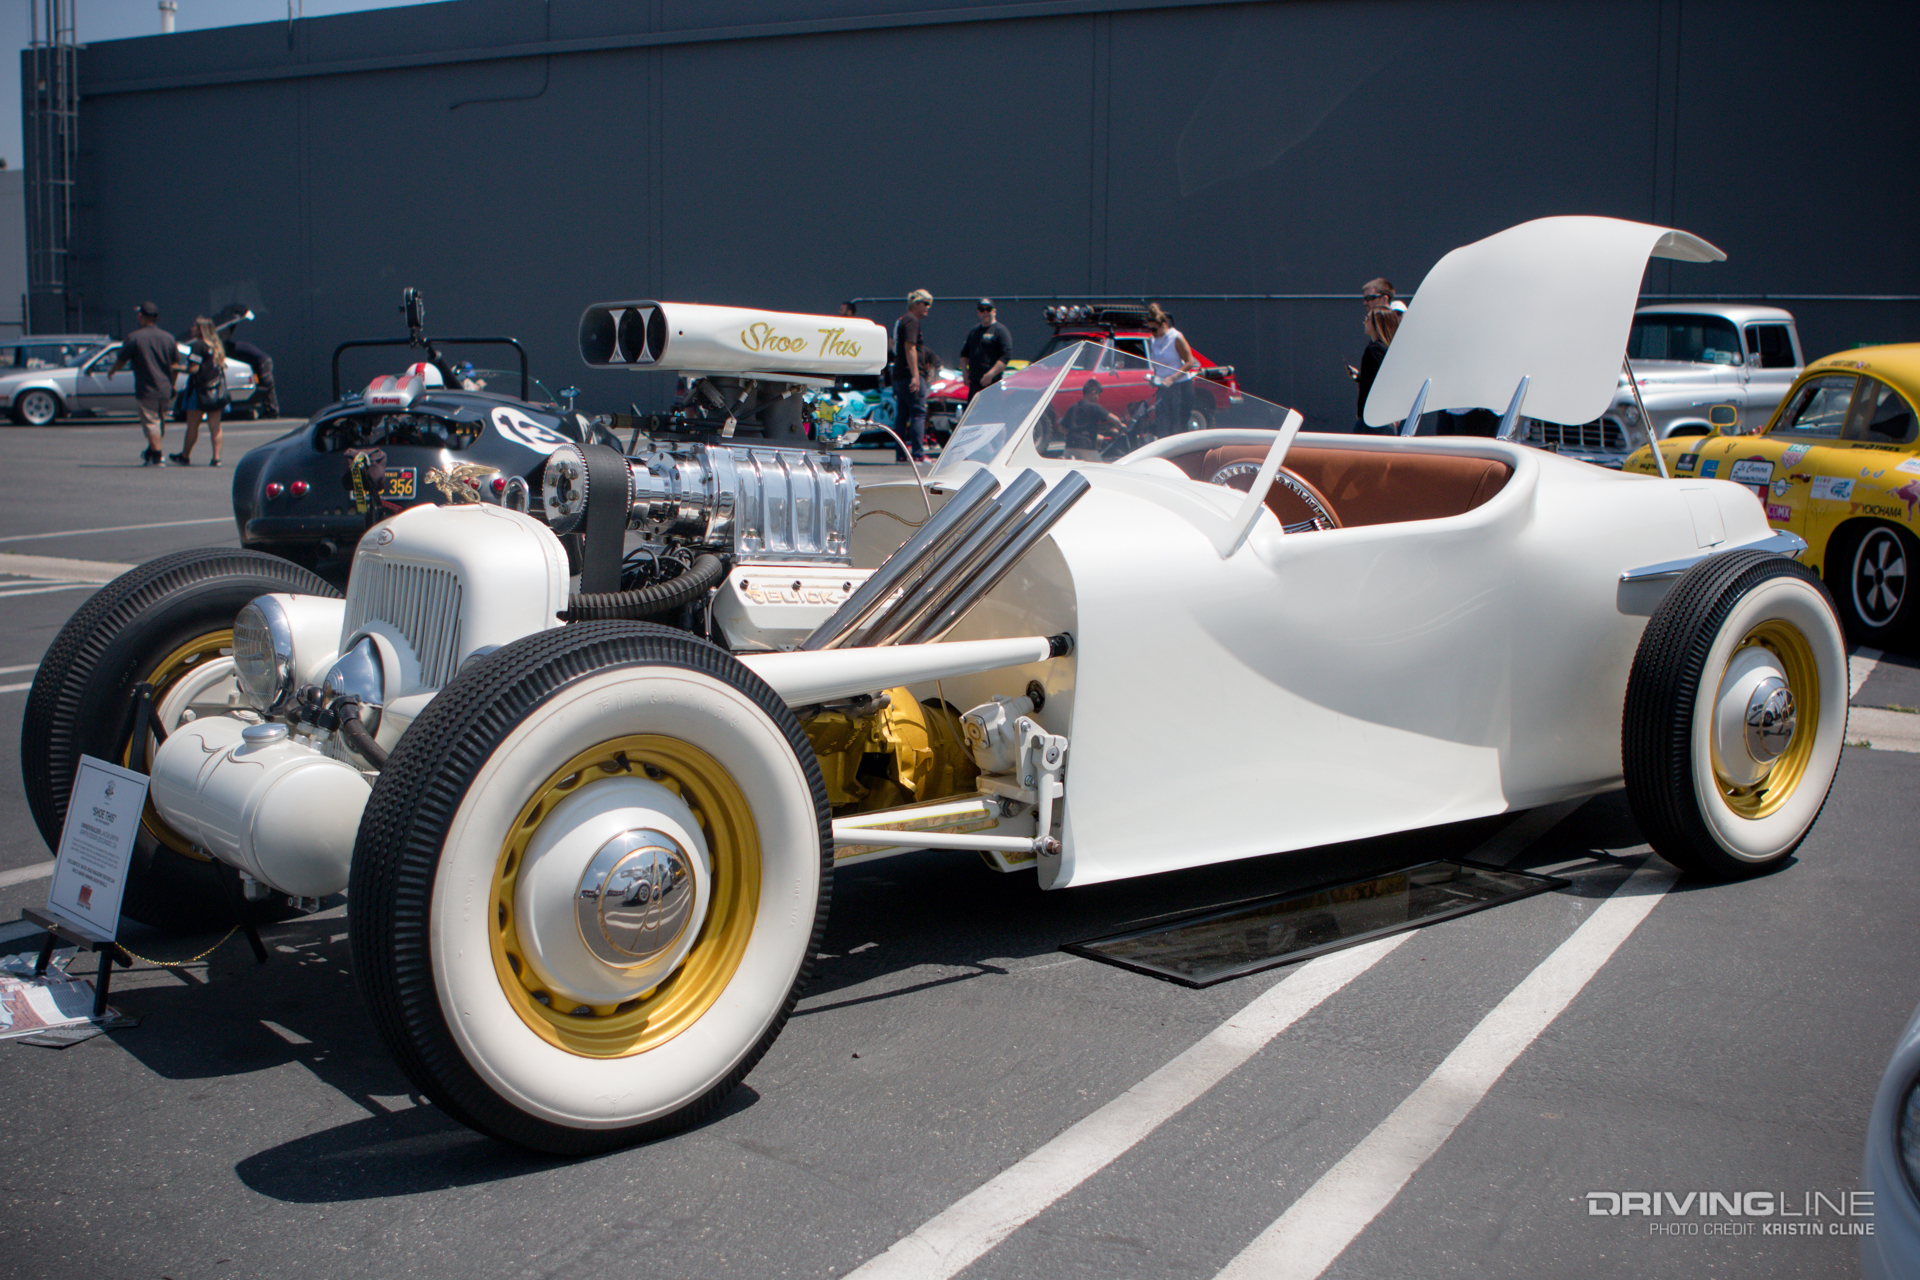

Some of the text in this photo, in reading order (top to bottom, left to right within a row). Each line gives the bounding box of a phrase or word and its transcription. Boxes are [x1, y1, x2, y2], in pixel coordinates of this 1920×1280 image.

[741, 321, 861, 358] Shoe This
[498, 414, 570, 444] 13
[1787, 444, 1811, 453] TAG
[389, 478, 413, 495] 356
[1768, 505, 1790, 519] CDMX
[1862, 504, 1902, 517] YOKOHAMA
[763, 590, 839, 605] BUICK
